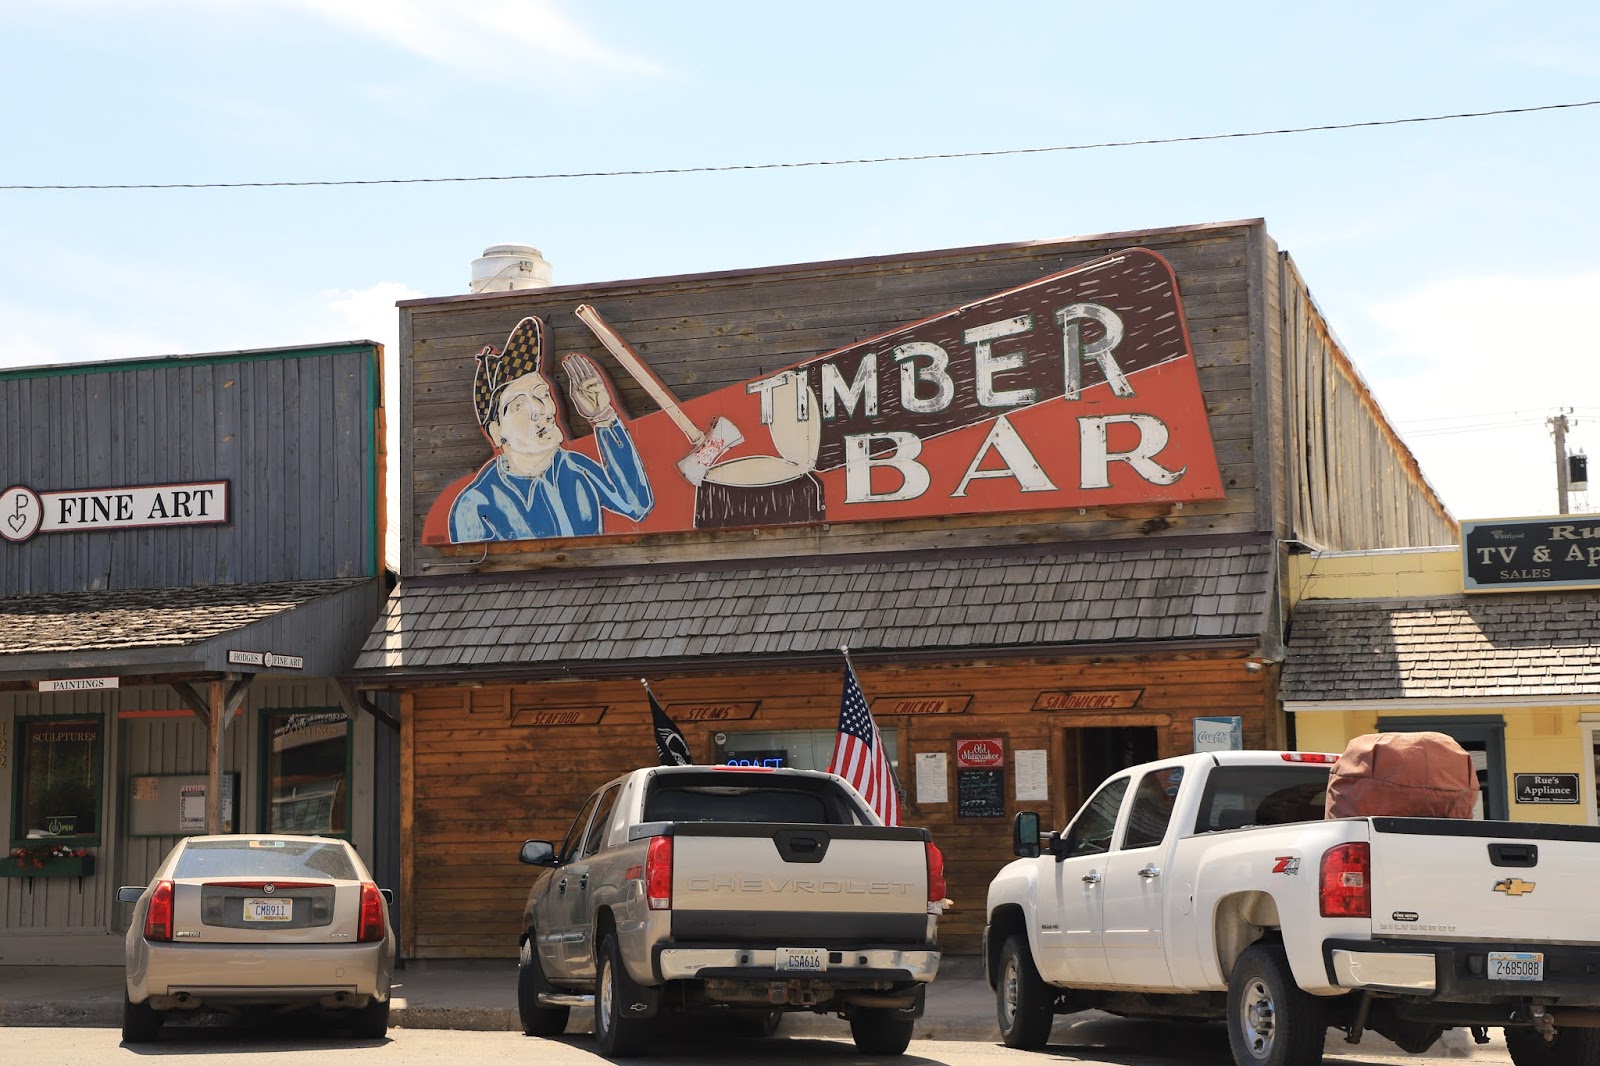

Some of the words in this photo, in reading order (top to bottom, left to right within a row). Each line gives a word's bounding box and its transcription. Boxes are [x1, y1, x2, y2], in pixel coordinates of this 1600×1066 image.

[746, 302, 1133, 425] TIMBER
[843, 413, 1187, 505] BAR
[58, 494, 134, 524] FINE
[147, 489, 213, 519] ART
[1476, 546, 1518, 565] TV
[1532, 545, 1552, 563] &
[1500, 568, 1551, 580] SALES
[233, 652, 259, 663] HODGES
[273, 656, 288, 666] FINE
[289, 658, 302, 667] ART
[53, 679, 104, 690] PAINTINGS
[893, 700, 944, 714] CHICKEN
[1045, 695, 1120, 709] SANDWICHES
[532, 711, 580, 725] SEAFOOD
[688, 706, 733, 720] STEAKS
[32, 732, 97, 743] SCULPTURES
[974, 743, 988, 753] Old
[1534, 776, 1560, 784] Rue's
[1524, 786, 1571, 796] Appliance
[687, 877, 914, 894] CHEVROLET
[255, 905, 285, 915] CMB911
